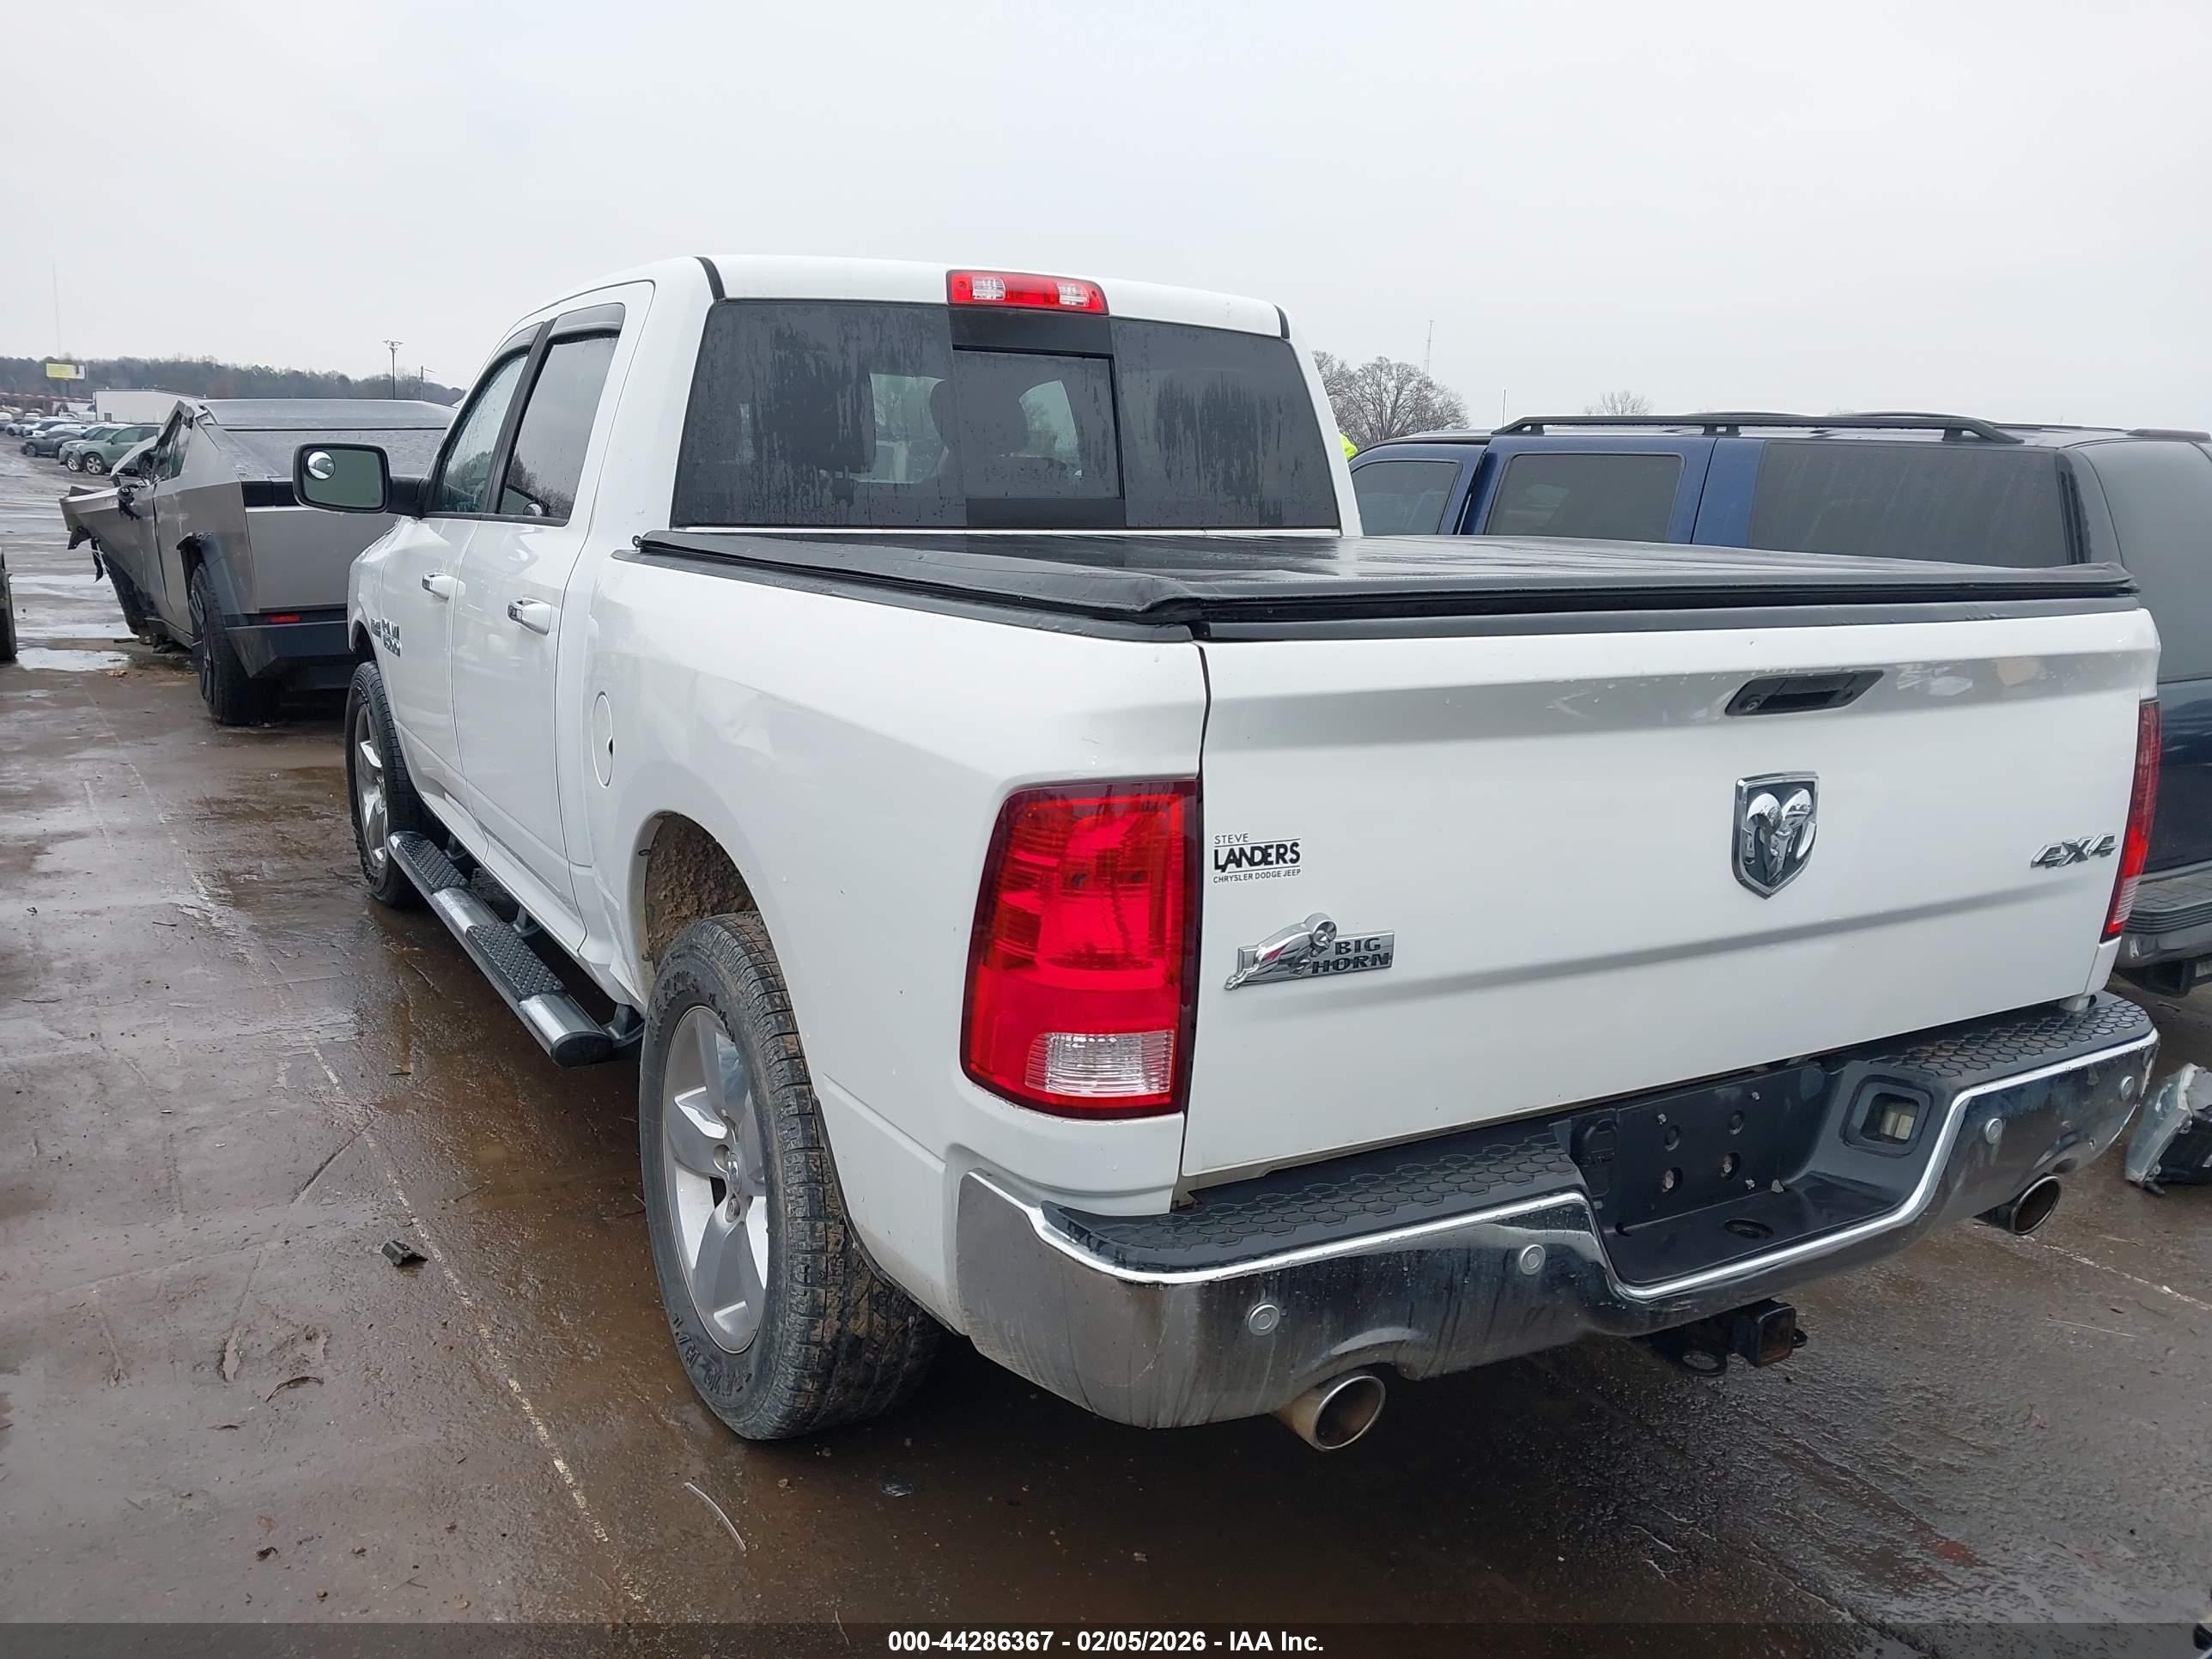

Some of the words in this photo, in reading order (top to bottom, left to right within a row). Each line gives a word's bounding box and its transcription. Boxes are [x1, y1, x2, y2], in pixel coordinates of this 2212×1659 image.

[1214, 833, 1249, 845] STEVE
[1213, 842, 1301, 873] LANDERS
[2030, 832, 2118, 869] 4X4
[1212, 872, 1254, 884] CHRYSLER
[1255, 870, 1282, 880] DODGE
[1283, 868, 1302, 877] JEEP
[1334, 937, 1382, 956] BIG
[1310, 952, 1389, 975] HORN
